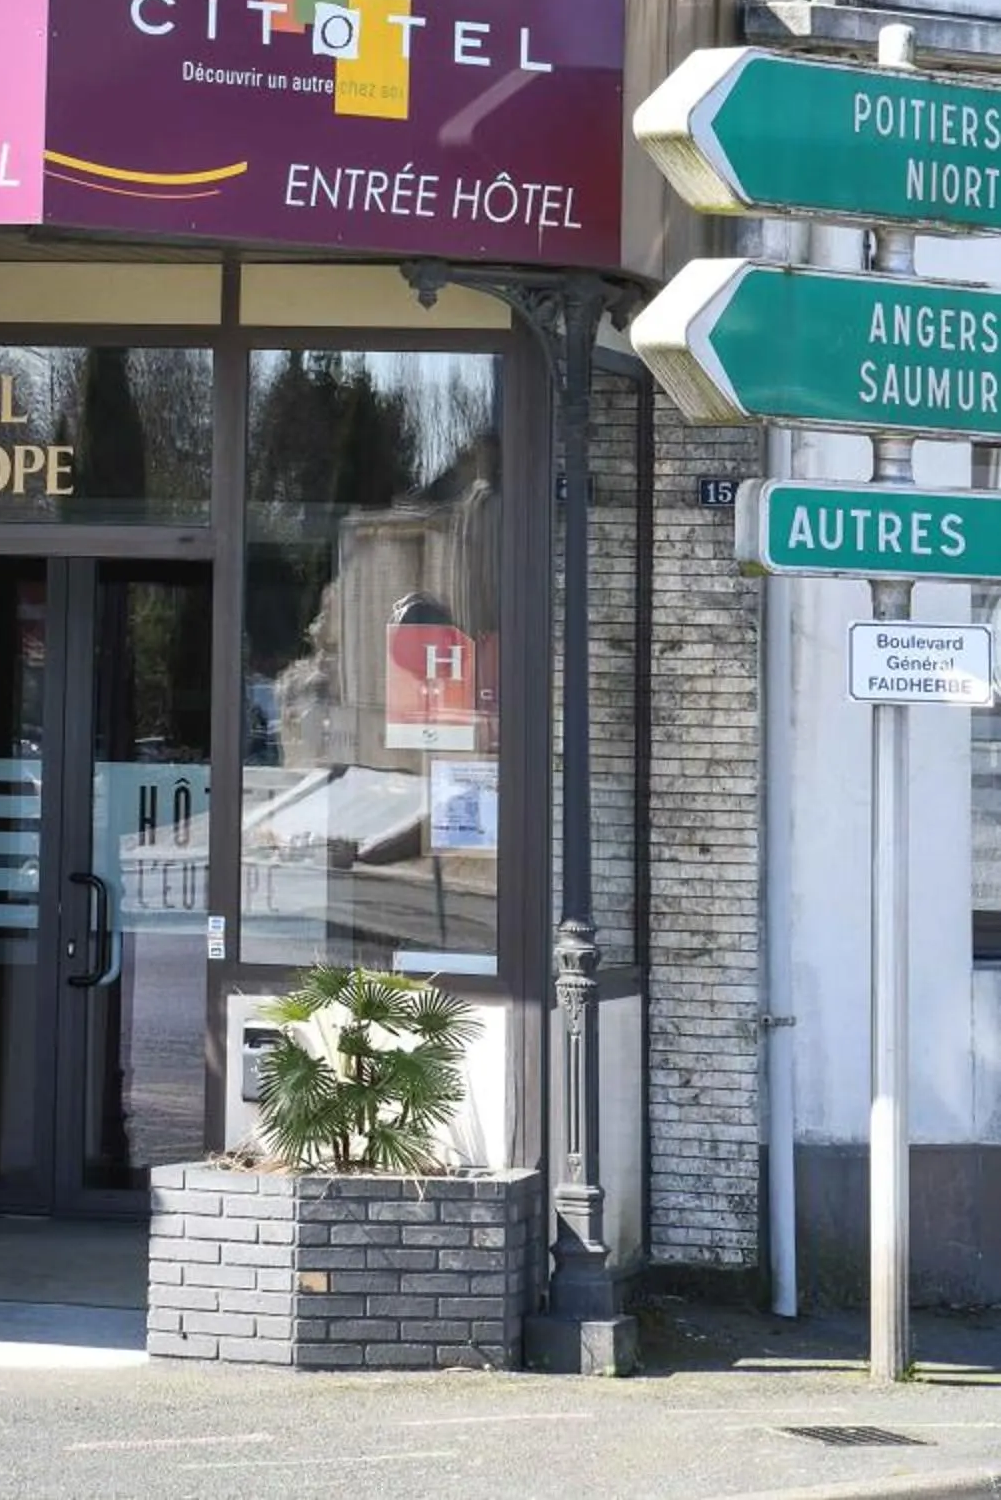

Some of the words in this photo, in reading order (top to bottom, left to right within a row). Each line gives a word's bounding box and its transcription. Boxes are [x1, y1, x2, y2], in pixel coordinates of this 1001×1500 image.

[182, 61, 263, 87] Découvrir
[268, 73, 287, 89] un
[292, 74, 333, 93] autre
[854, 92, 1001, 150] POITIERS
[285, 162, 437, 216] ENTRÉE
[452, 172, 582, 229] HÔTEL
[907, 158, 1000, 209] NIORT
[868, 302, 998, 353] ANGERS
[859, 361, 998, 413] SAUMUR
[706, 482, 732, 503] 15
[787, 505, 967, 557] AUTRES
[876, 633, 964, 651] Boulevard
[886, 655, 954, 671] Général
